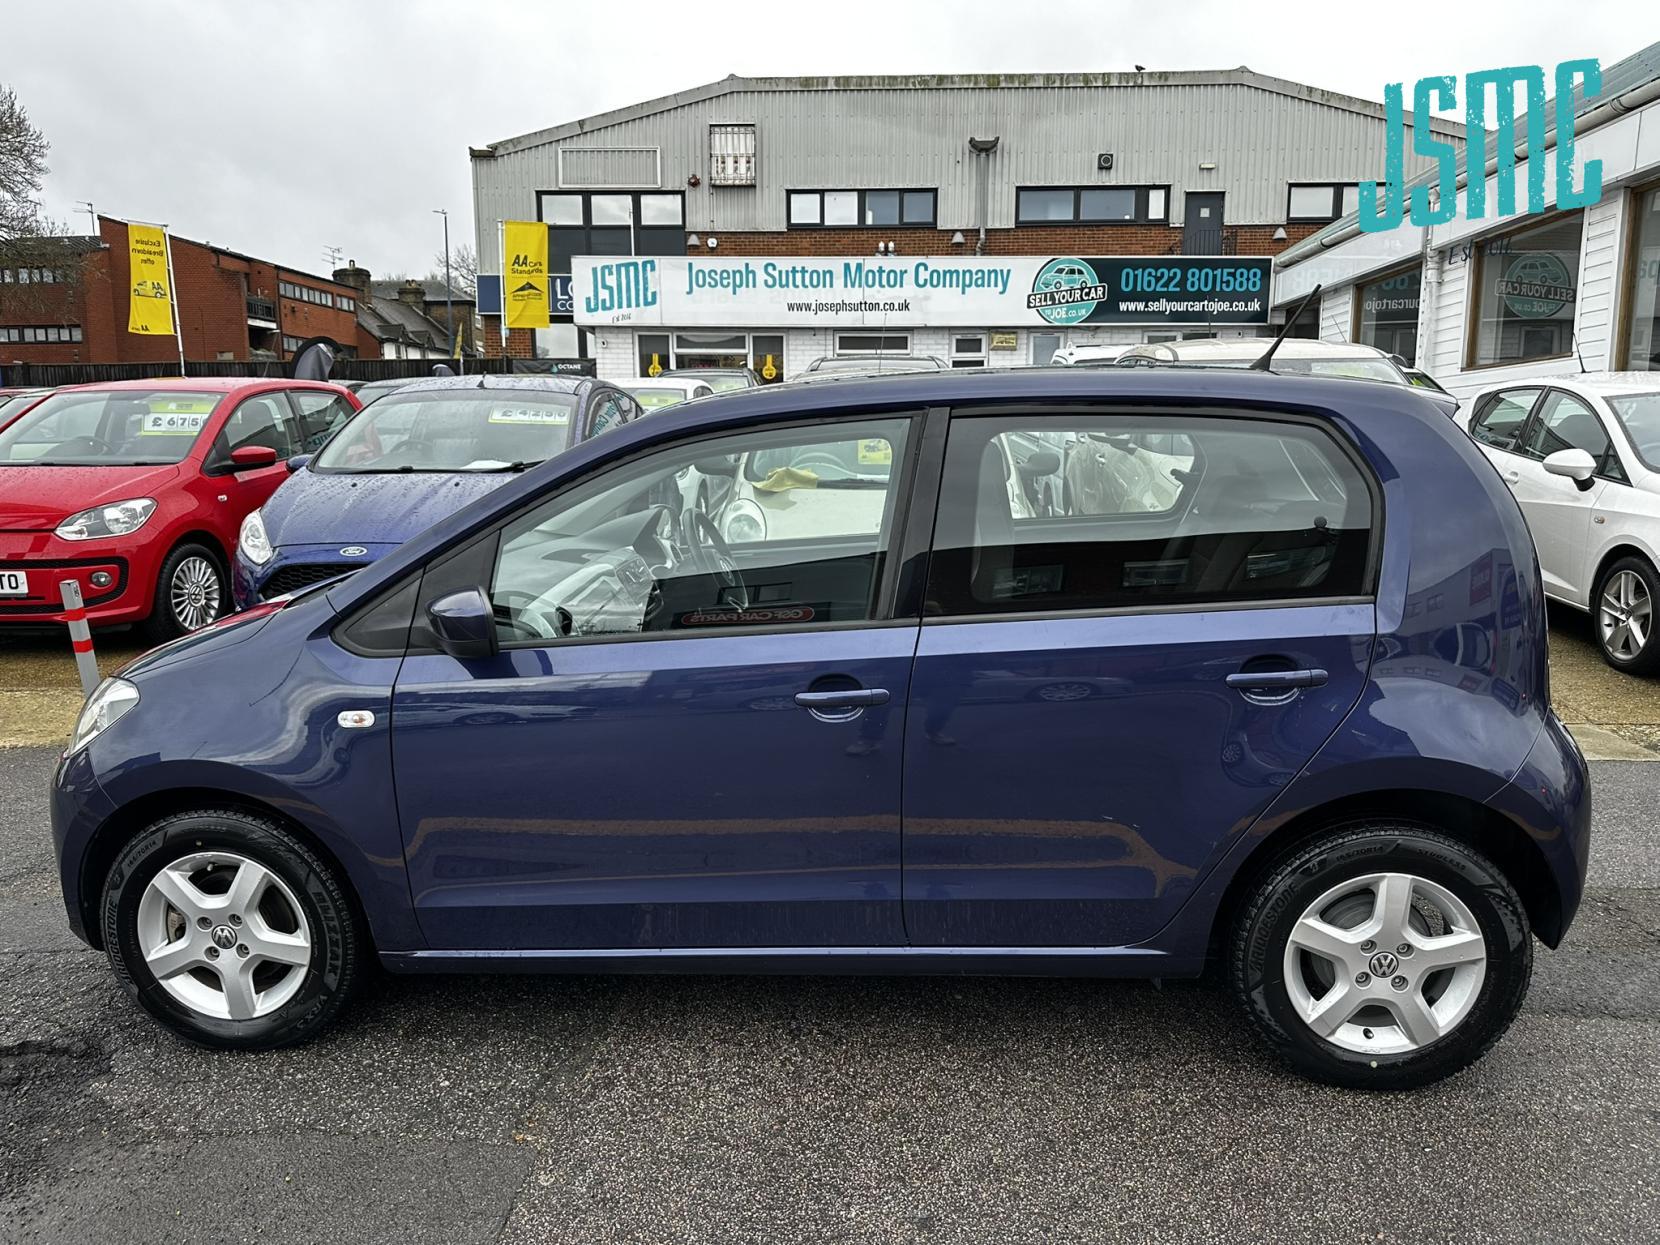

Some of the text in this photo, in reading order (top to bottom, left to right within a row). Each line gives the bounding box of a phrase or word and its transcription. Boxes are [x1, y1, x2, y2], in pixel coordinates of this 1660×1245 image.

[511, 267, 544, 275] Standards
[512, 254, 543, 268] AA Cars
[585, 259, 657, 313] JSMC
[686, 261, 1011, 295] Joseph Sutton Motor Company
[1120, 267, 1261, 292] 01622 801588
[787, 299, 910, 315] www.josephsutton.co.uk
[1029, 286, 1104, 307] SELL YOUR CAR
[1119, 298, 1261, 315] www.sellyourcartojoe.co.uk
[106, 899, 133, 986] BRIDGESTONE
